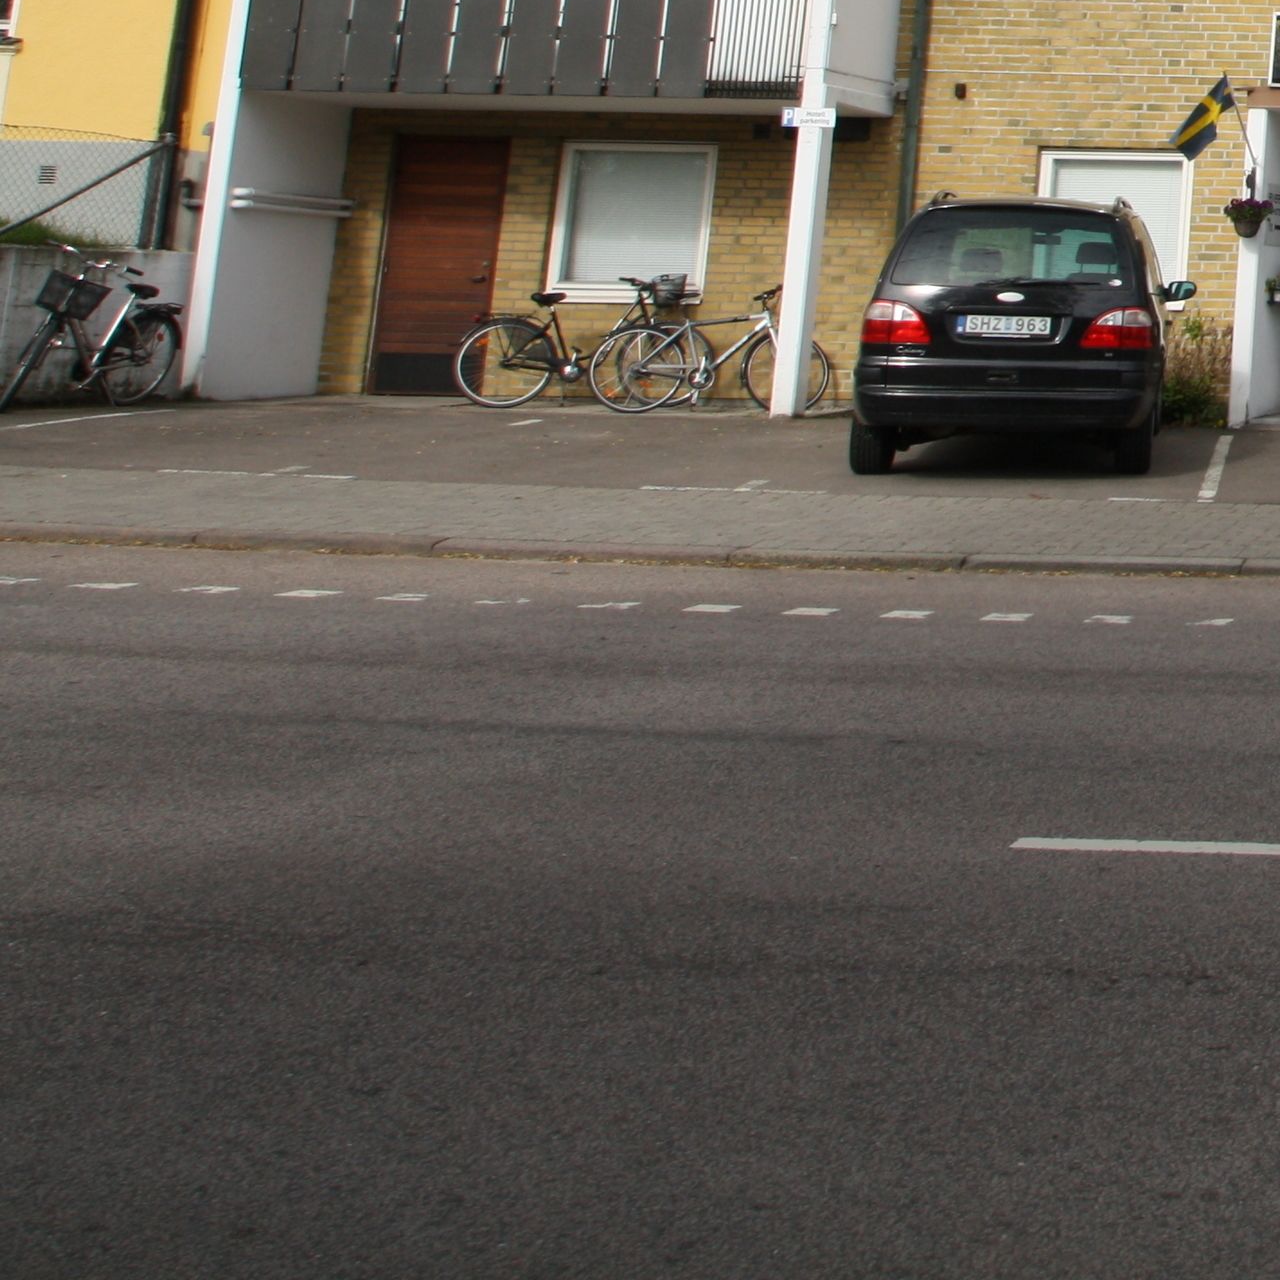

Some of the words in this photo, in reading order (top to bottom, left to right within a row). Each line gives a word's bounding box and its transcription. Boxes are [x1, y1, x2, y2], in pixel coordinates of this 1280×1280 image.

[783, 108, 794, 125] P
[968, 317, 1000, 331] SHZ
[1015, 319, 1048, 332] 963
